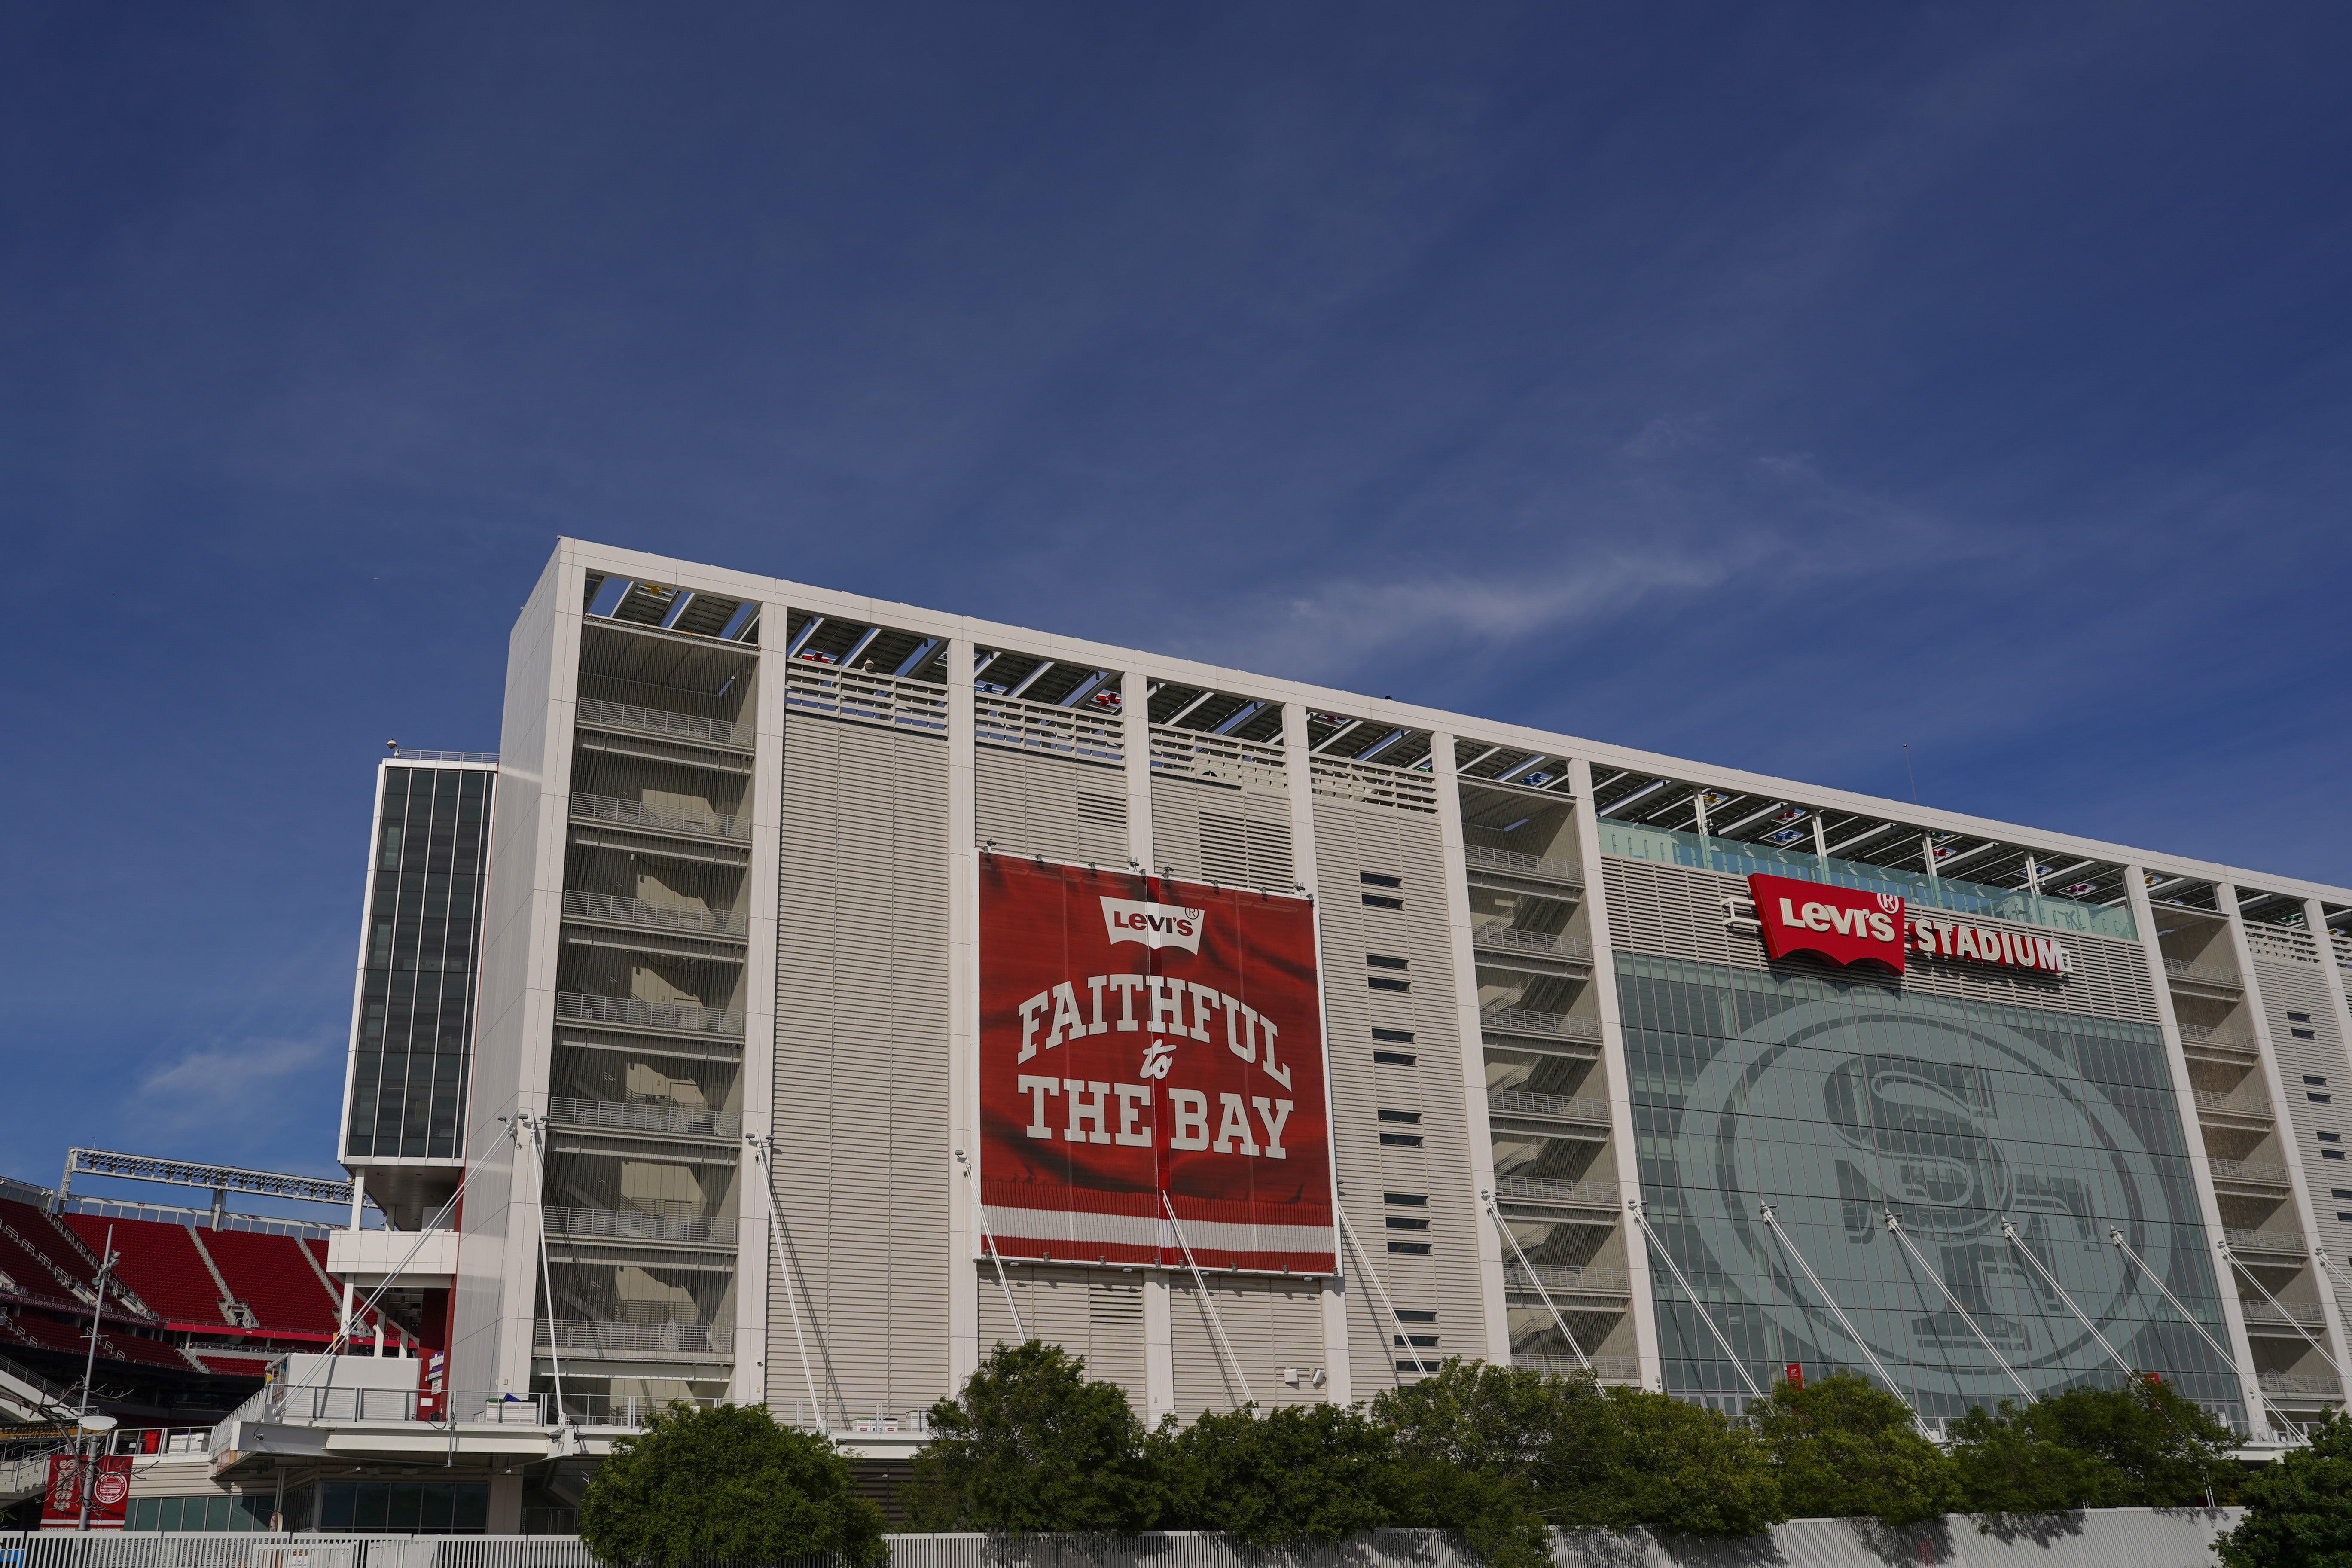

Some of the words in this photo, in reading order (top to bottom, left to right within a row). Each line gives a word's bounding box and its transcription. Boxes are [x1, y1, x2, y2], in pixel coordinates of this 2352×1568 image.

[1914, 918, 2063, 972] STADIUM
[1017, 973, 1292, 1092] FAITHFUL
[1139, 1038, 1177, 1080] to
[1017, 1074, 1152, 1148] THE
[1168, 1088, 1293, 1160] BAY
[102, 1312, 128, 1322] DESCRIPTION,
